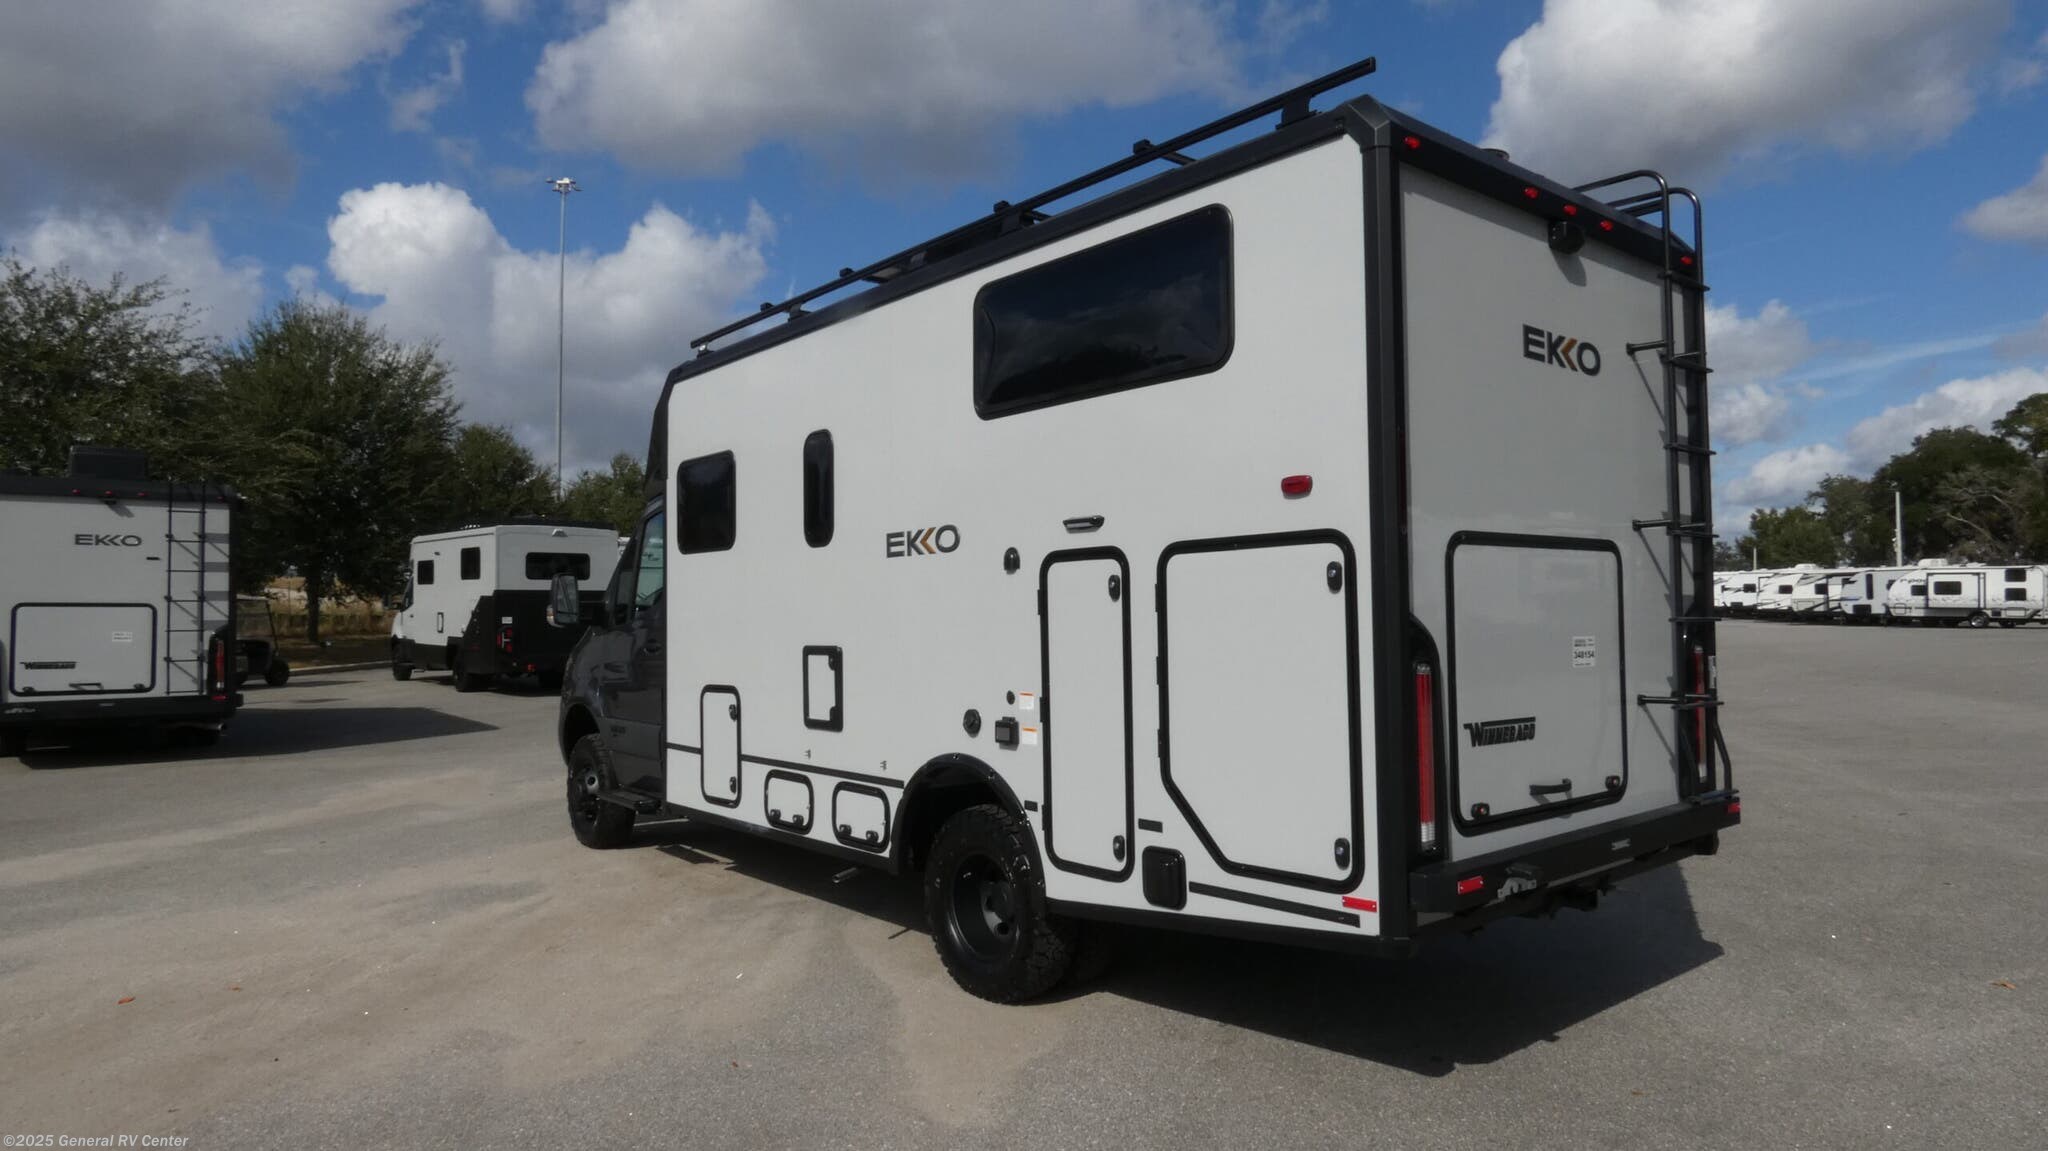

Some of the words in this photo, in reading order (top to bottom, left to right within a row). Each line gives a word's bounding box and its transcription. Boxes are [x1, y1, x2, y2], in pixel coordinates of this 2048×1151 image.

[1522, 323, 1601, 376] EKKO
[75, 534, 142, 547] EKKO
[886, 524, 961, 558] EKKO
